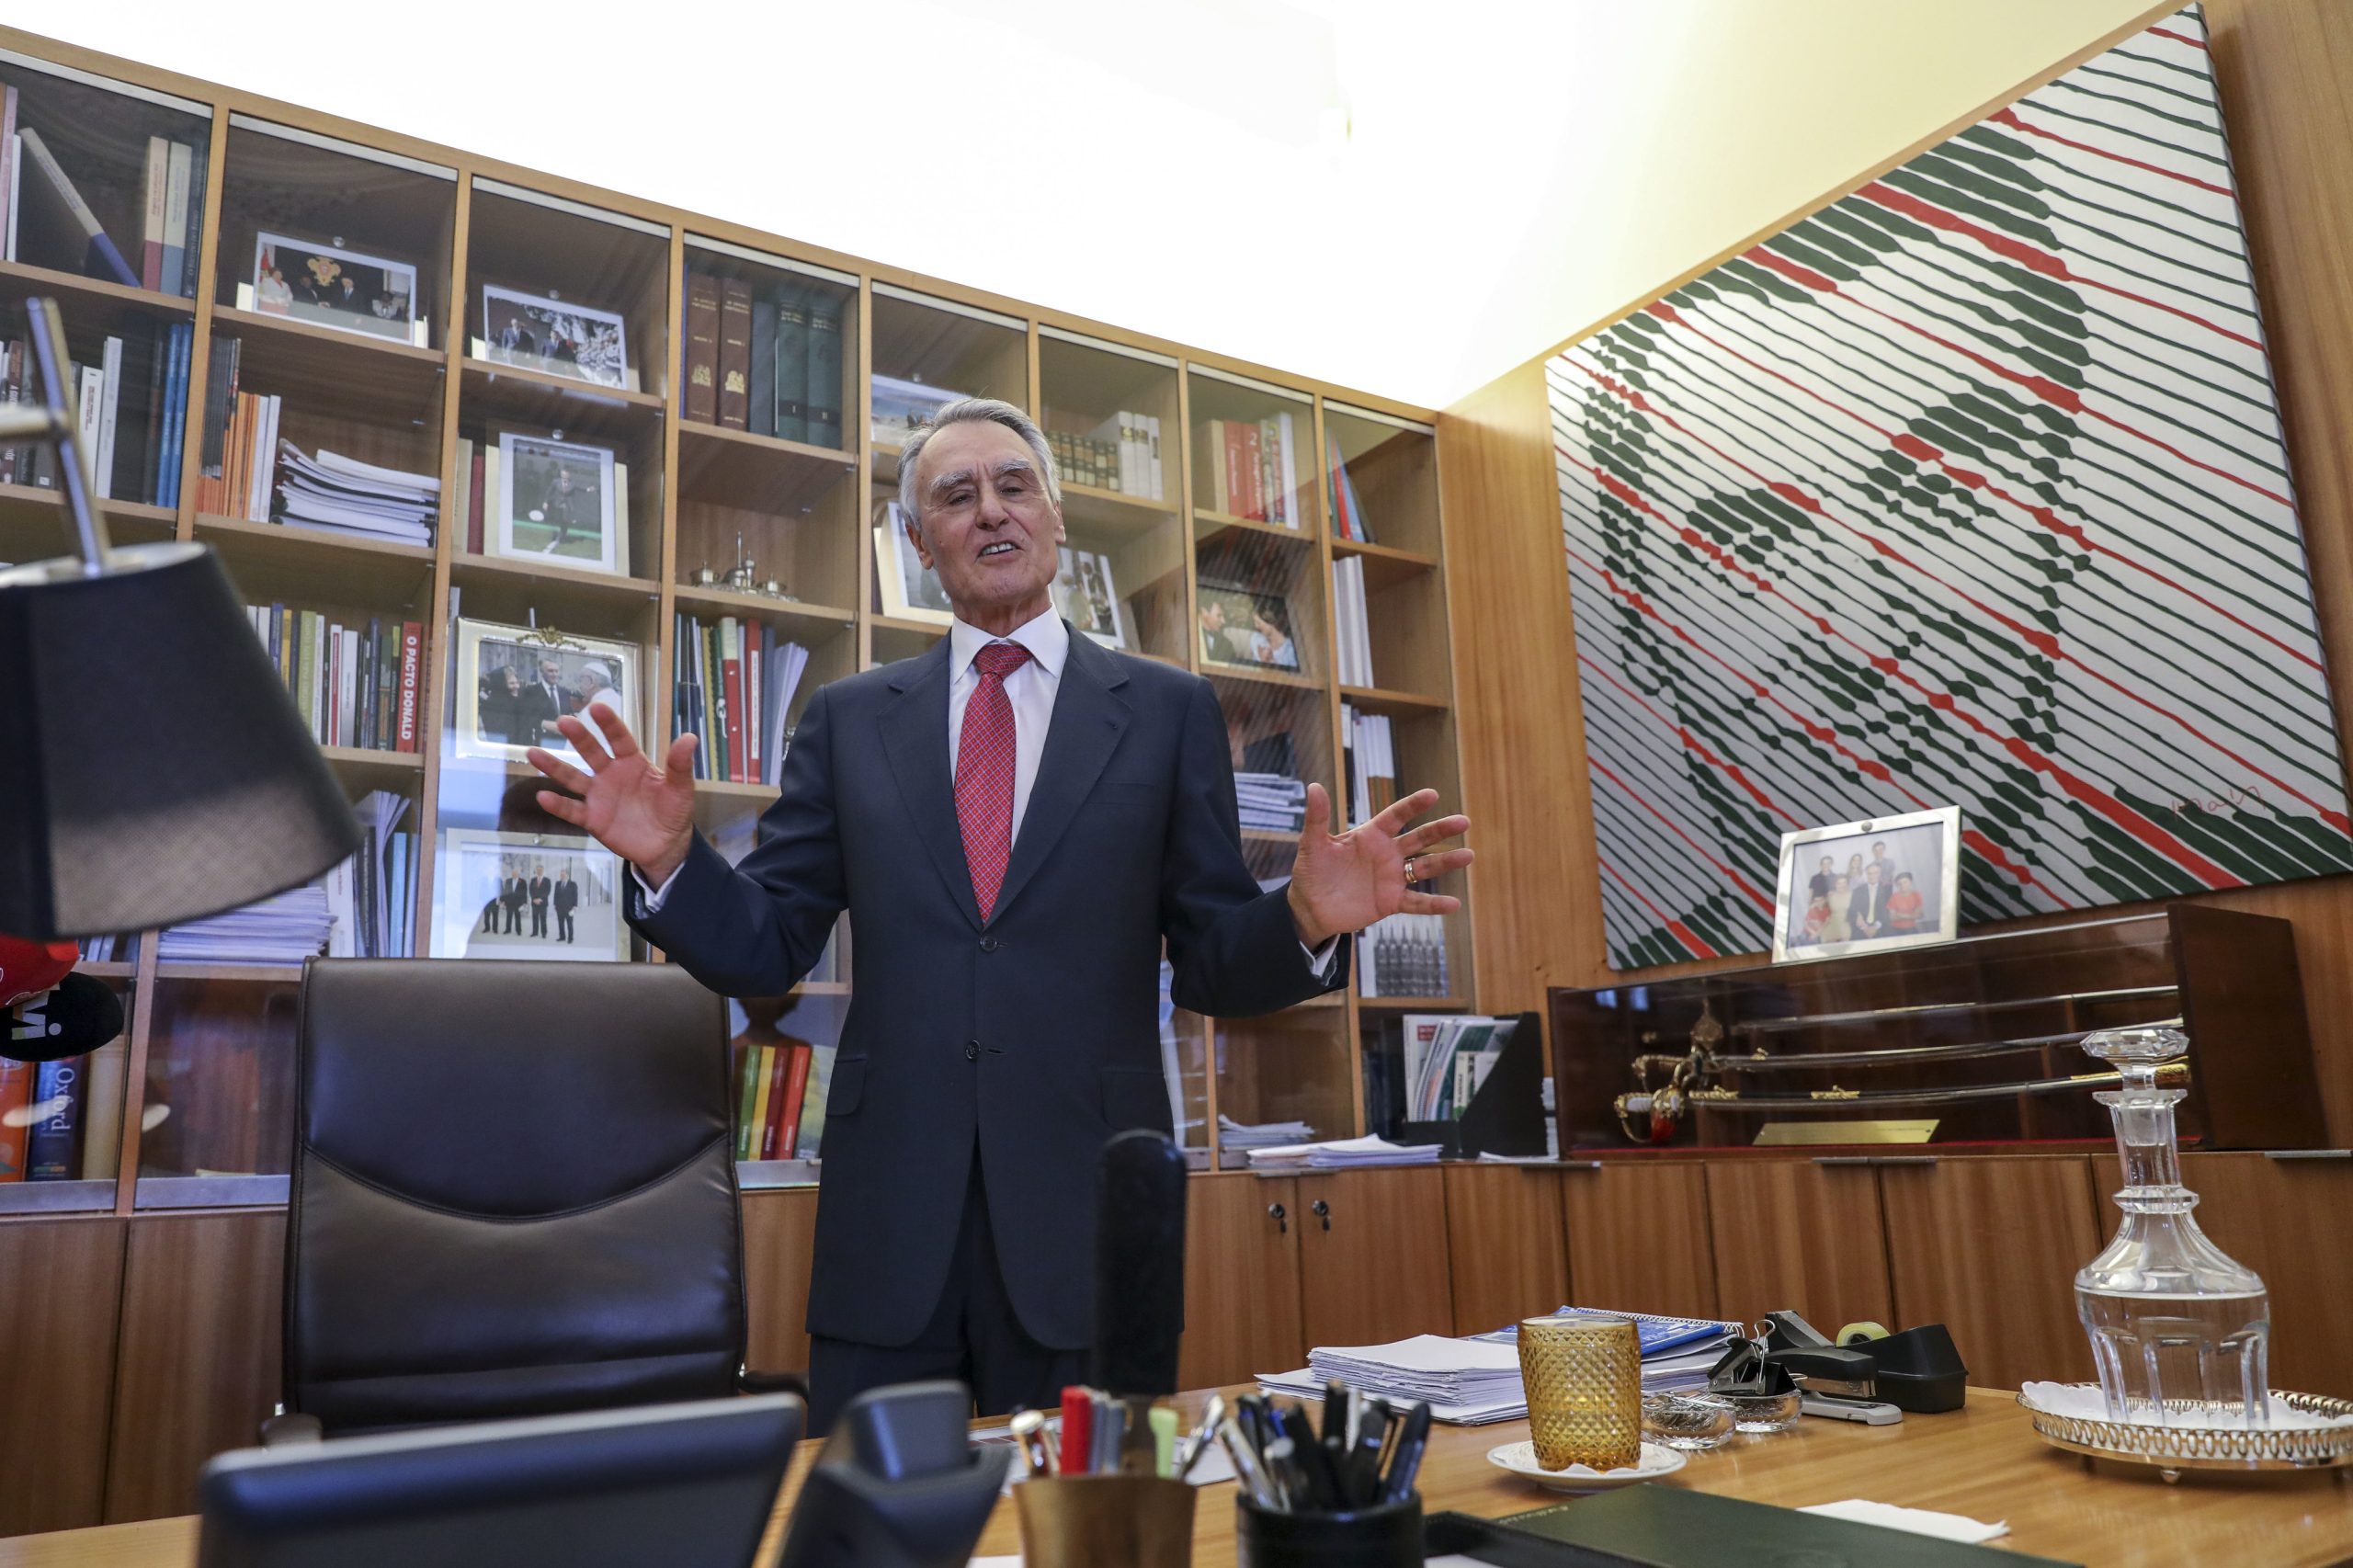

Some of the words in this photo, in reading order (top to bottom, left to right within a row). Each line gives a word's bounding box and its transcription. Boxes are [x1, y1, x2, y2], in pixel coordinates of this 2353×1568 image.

[406, 635, 417, 646] O
[404, 647, 416, 687] PACTO
[401, 689, 415, 741] DONALD
[51, 1067, 75, 1131] Oxford
